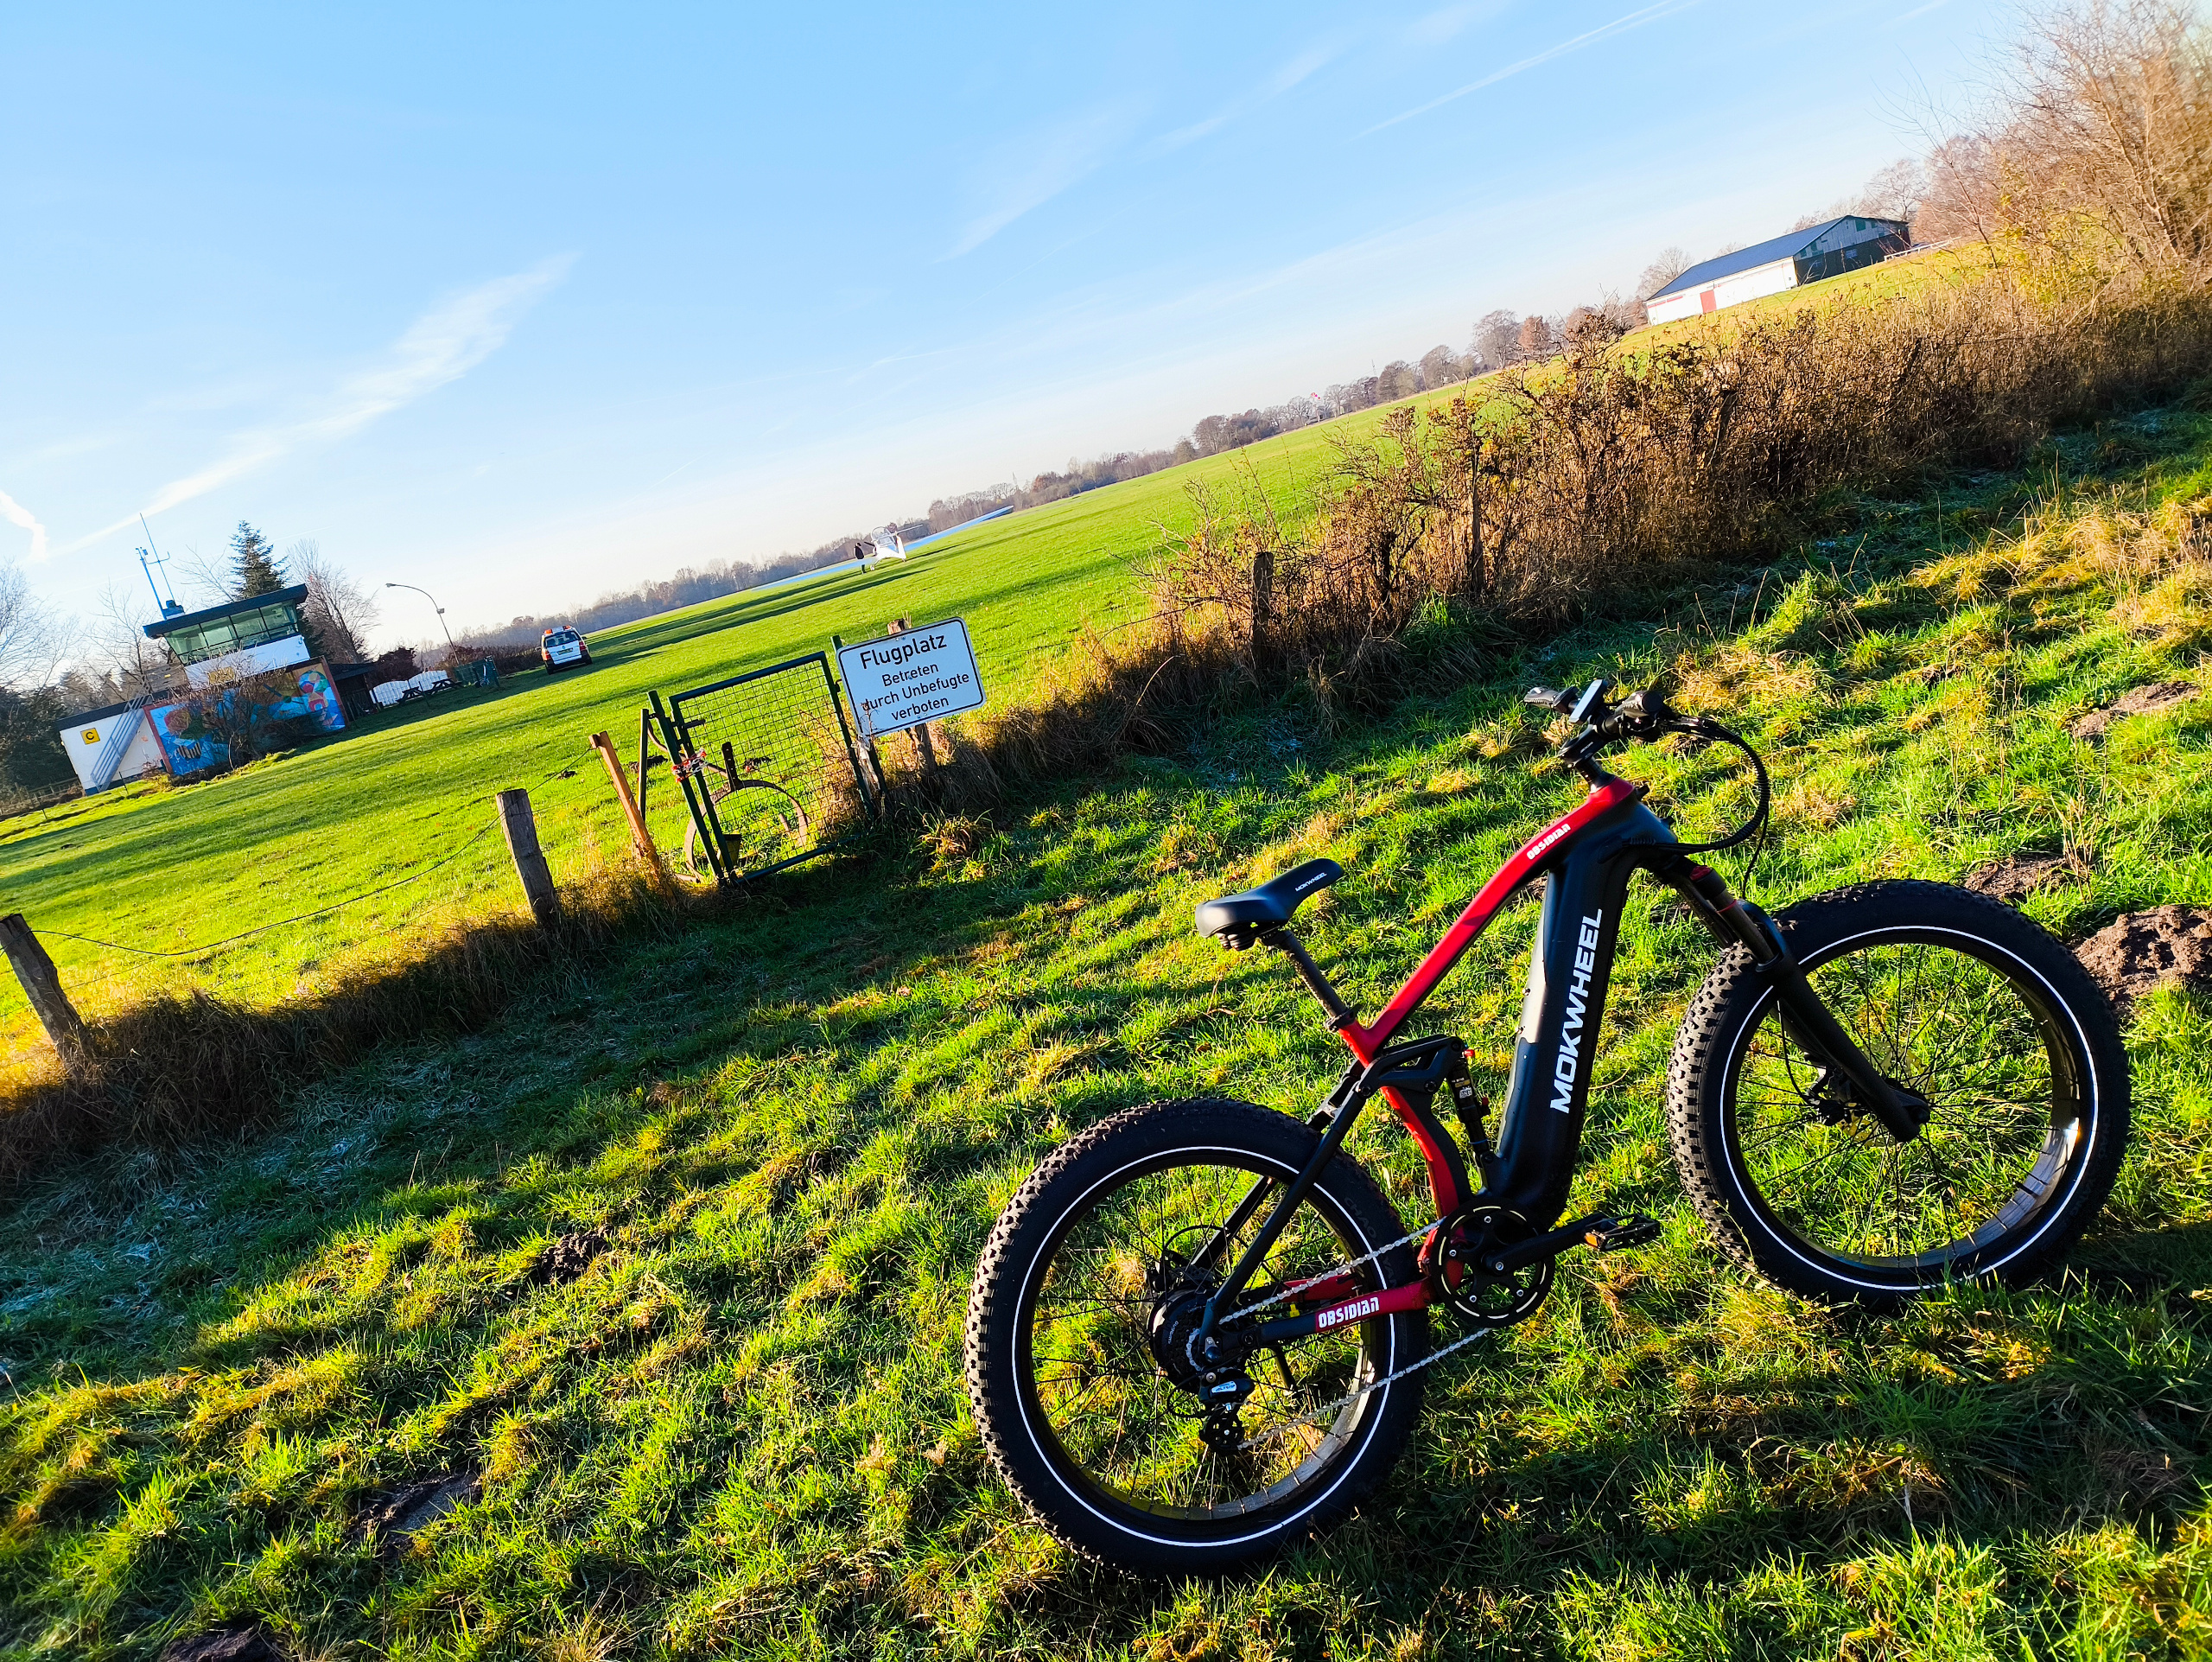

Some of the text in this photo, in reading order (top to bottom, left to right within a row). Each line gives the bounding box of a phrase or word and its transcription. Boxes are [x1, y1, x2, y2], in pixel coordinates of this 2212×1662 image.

[860, 634, 947, 669] Flugplatz
[881, 664, 939, 686] Betreten
[862, 672, 969, 711] durch Unbefugte
[891, 697, 950, 721] verboten
[86, 731, 94, 741] C
[1295, 872, 1327, 892] MOKWHEEL
[1550, 908, 1603, 1114] MOKWHEEL
[1343, 1196, 1379, 1240] CHAO
